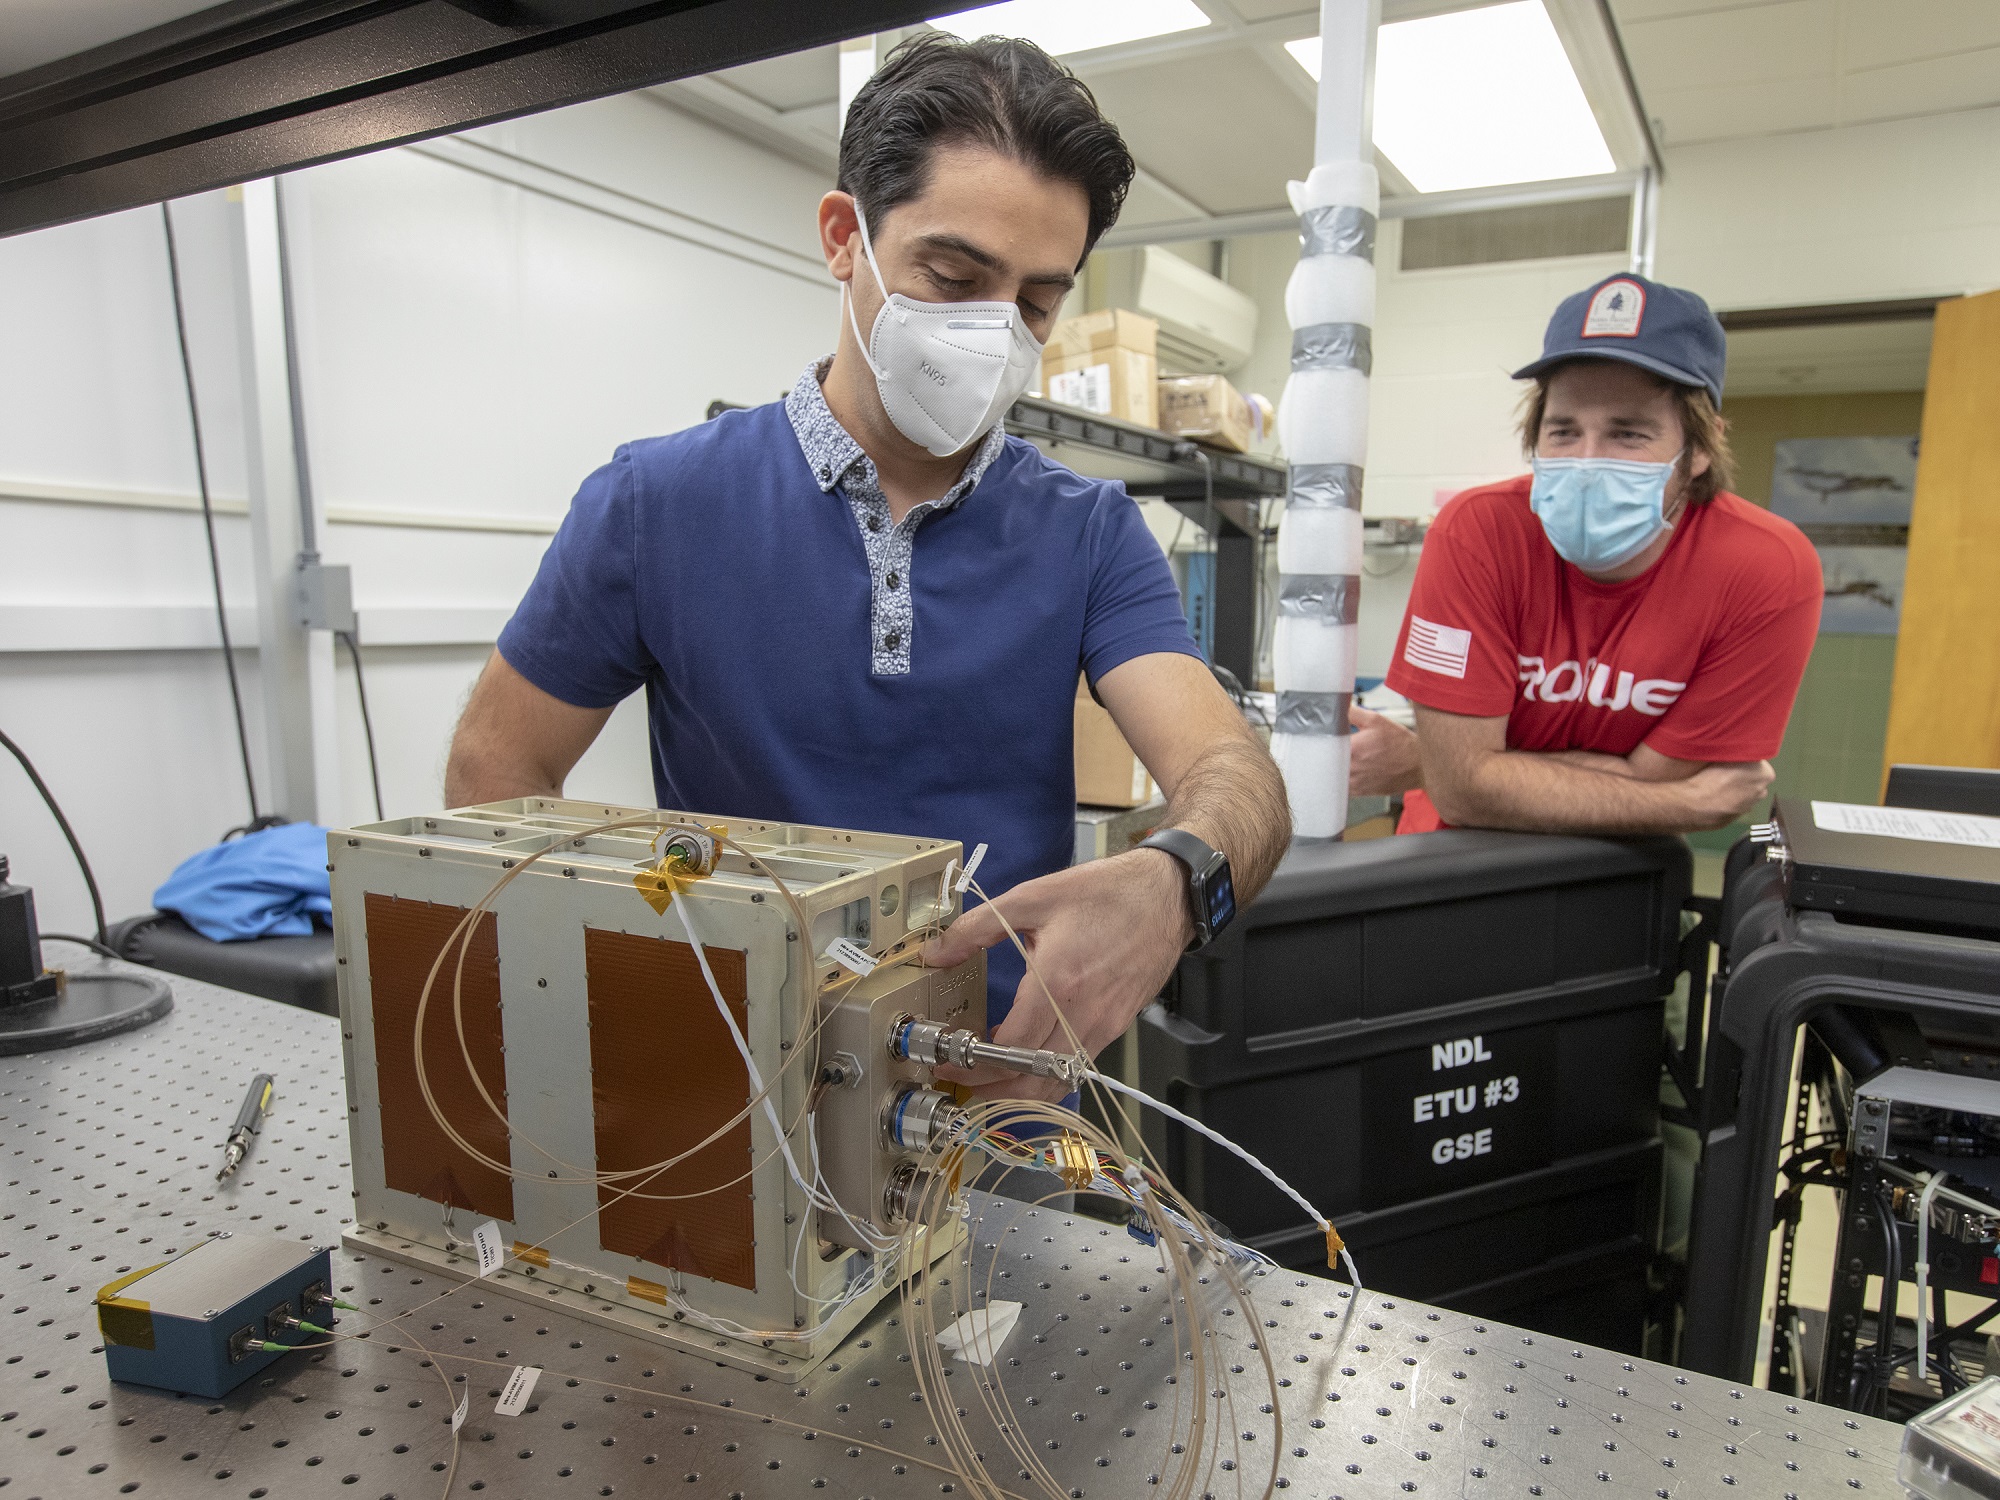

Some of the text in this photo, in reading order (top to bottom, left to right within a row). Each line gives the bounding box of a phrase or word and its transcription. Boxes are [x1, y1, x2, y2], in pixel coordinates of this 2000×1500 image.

[920, 361, 947, 386] KN95
[1432, 1035, 1493, 1071] NDL
[1413, 1075, 1520, 1123] ETU #3
[1431, 1127, 1493, 1165] GSE
[477, 1232, 490, 1268] DIAMOND
